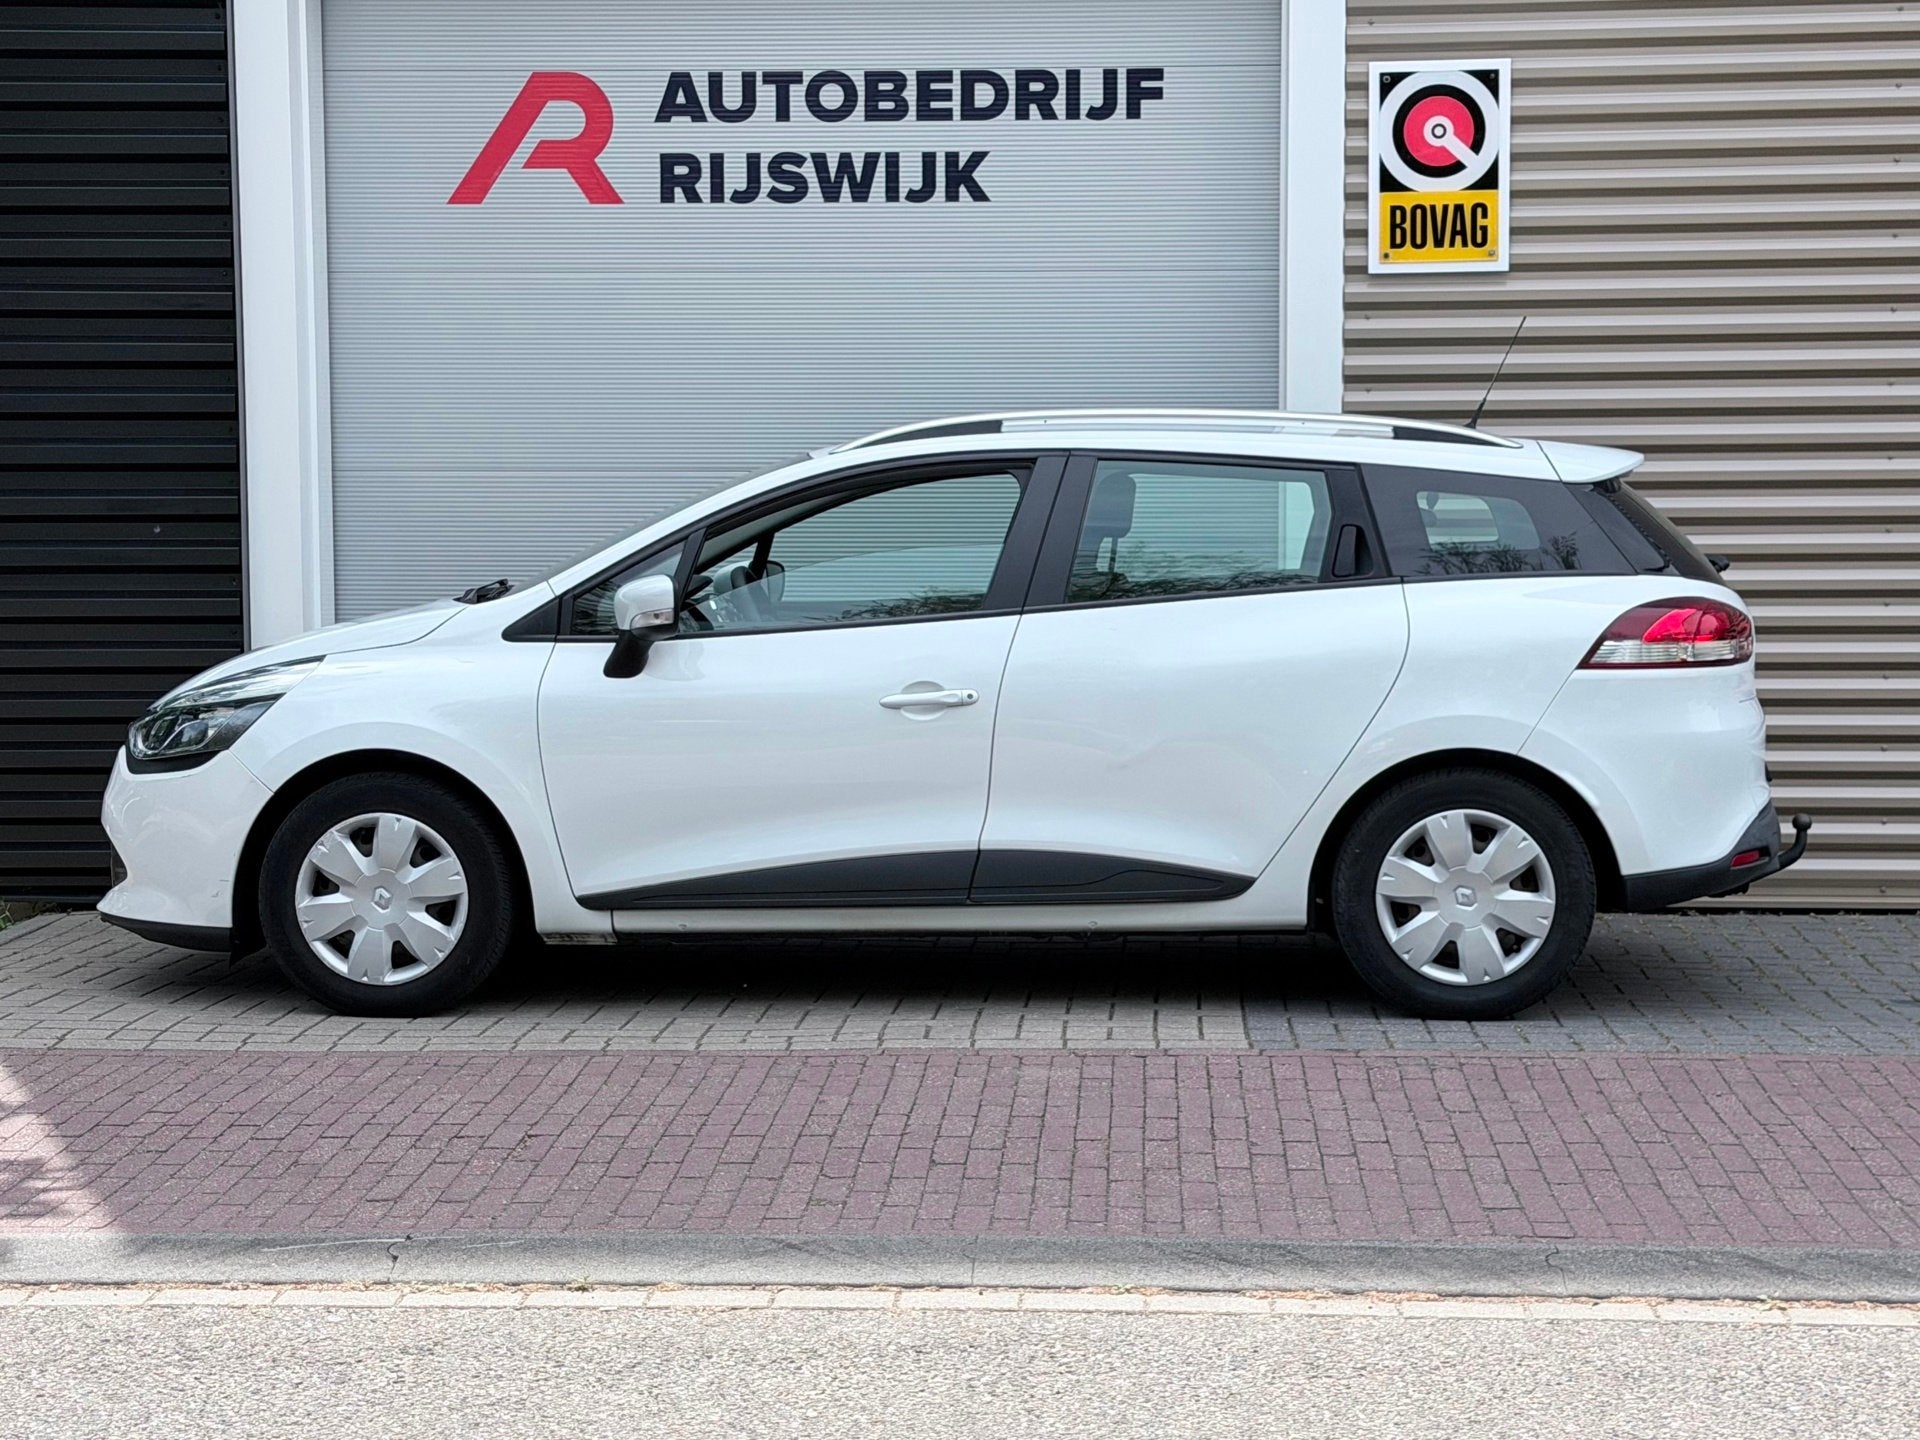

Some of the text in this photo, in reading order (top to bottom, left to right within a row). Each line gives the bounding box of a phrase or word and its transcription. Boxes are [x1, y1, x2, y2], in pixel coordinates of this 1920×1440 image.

[655, 68, 1164, 123] AUTOBEDRIJF
[660, 151, 991, 204] RIJSWIJK
[1389, 202, 1489, 249] BOVAG
